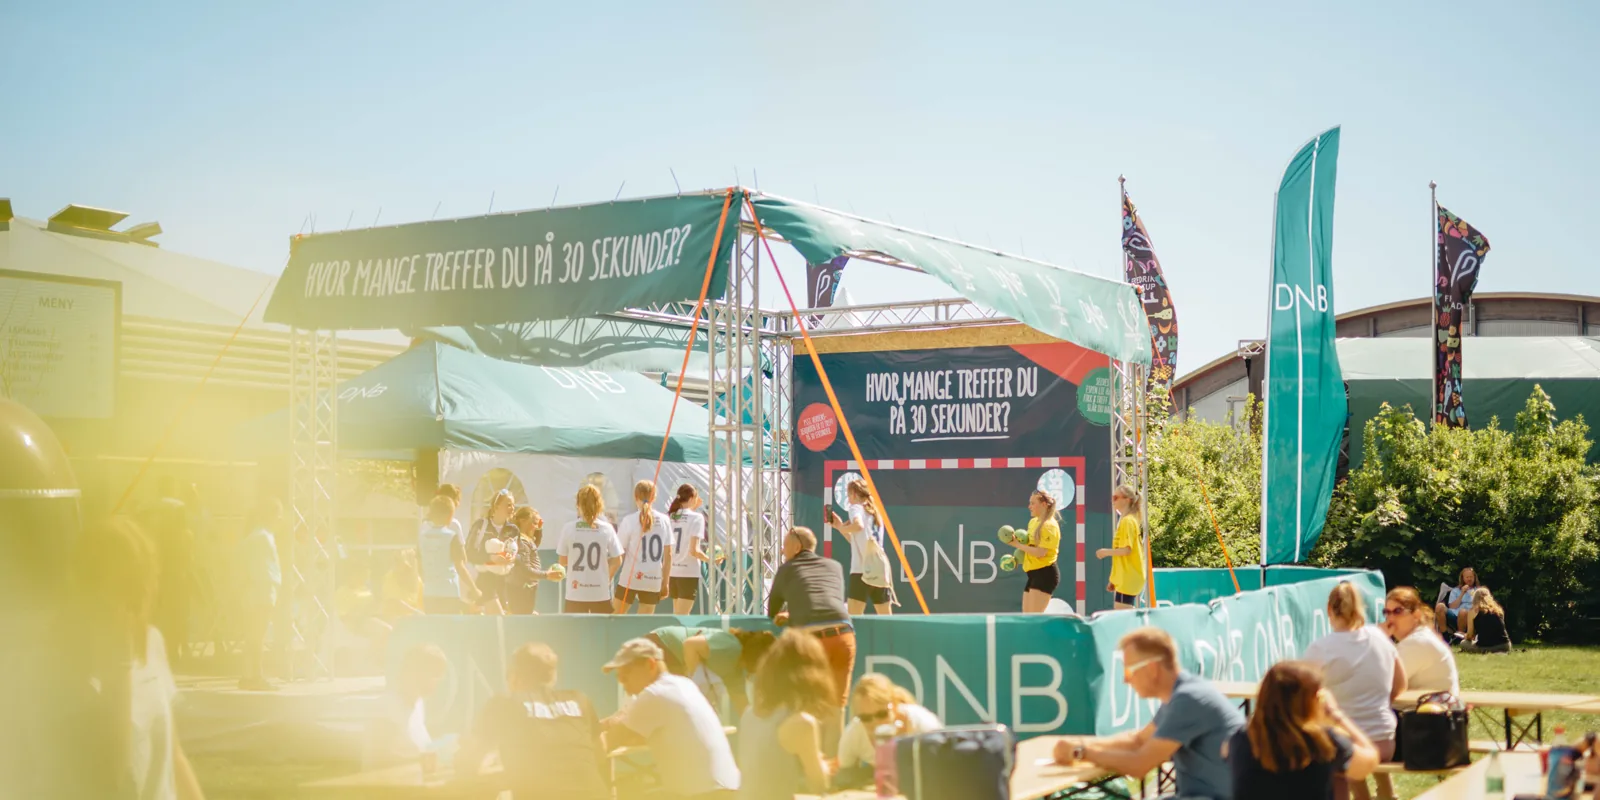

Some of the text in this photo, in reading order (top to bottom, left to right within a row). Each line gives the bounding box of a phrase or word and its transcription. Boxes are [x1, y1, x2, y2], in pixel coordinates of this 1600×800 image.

[304, 223, 692, 298] HVOR MANGE TREFFER DU PÅ 30 SEKUNDER?
[38, 296, 74, 309] MENY
[1275, 283, 1328, 314] DNB
[337, 382, 388, 402] DNB
[541, 366, 627, 401] DNB
[866, 366, 1038, 402] HVOR MANGE TREFFER DU
[889, 398, 1011, 435] PÅ 30 SEKUNDER?
[572, 541, 601, 572] 20
[641, 533, 663, 563] 10
[673, 527, 682, 554] 7
[900, 524, 998, 600] DNB
[866, 614, 1068, 733] DNB
